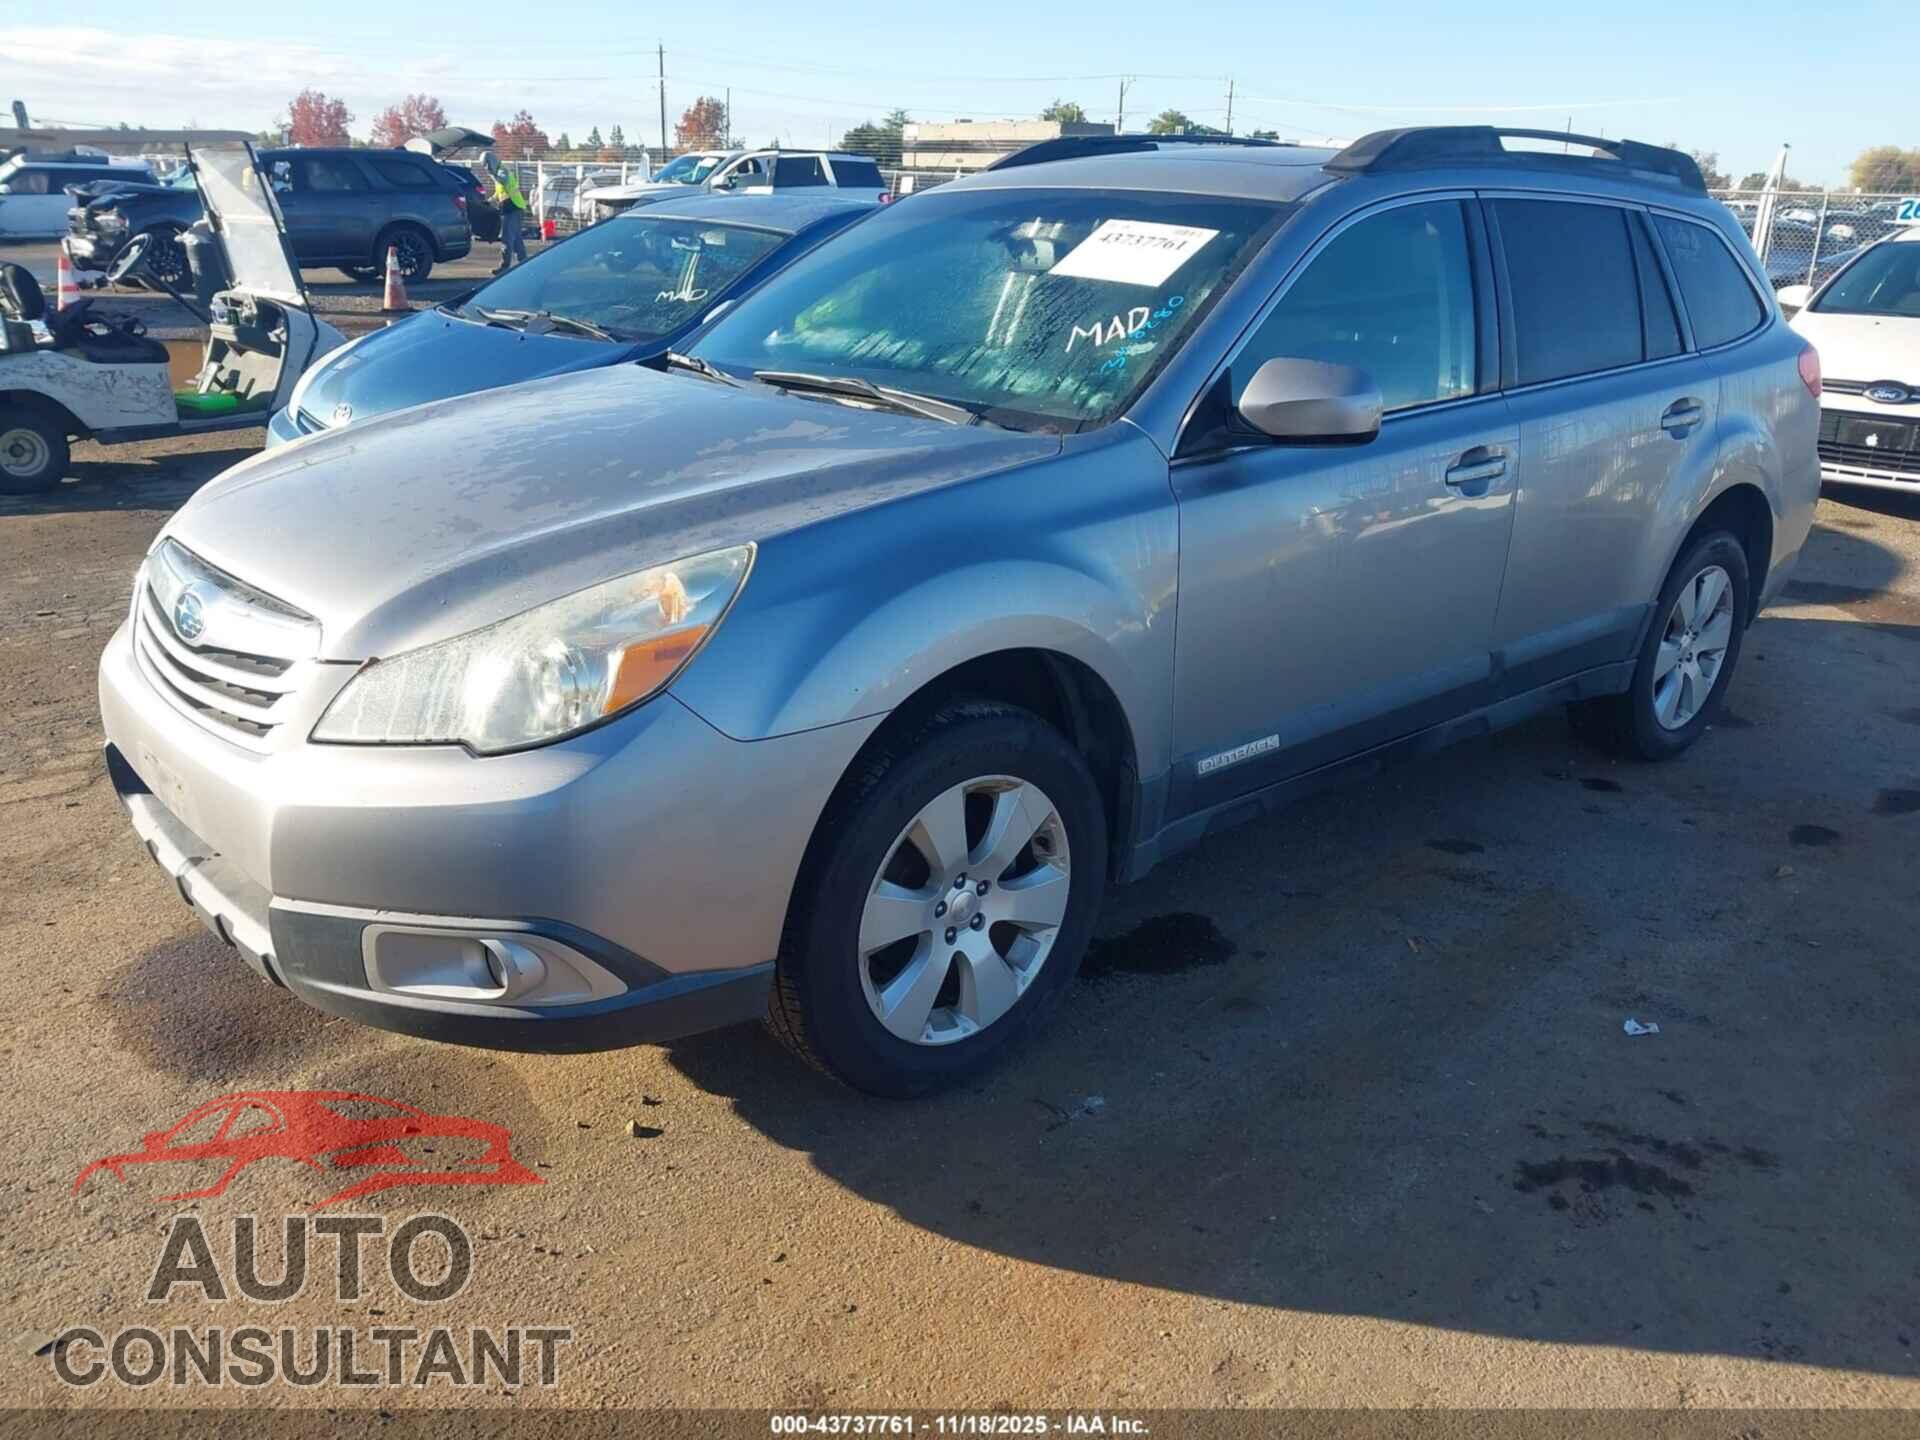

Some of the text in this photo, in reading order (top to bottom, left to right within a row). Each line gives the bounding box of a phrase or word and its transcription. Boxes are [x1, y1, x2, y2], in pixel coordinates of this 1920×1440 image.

[1099, 232, 1188, 250] 43737761
[1064, 306, 1150, 353] MAD
[1873, 385, 1898, 400] Ford
